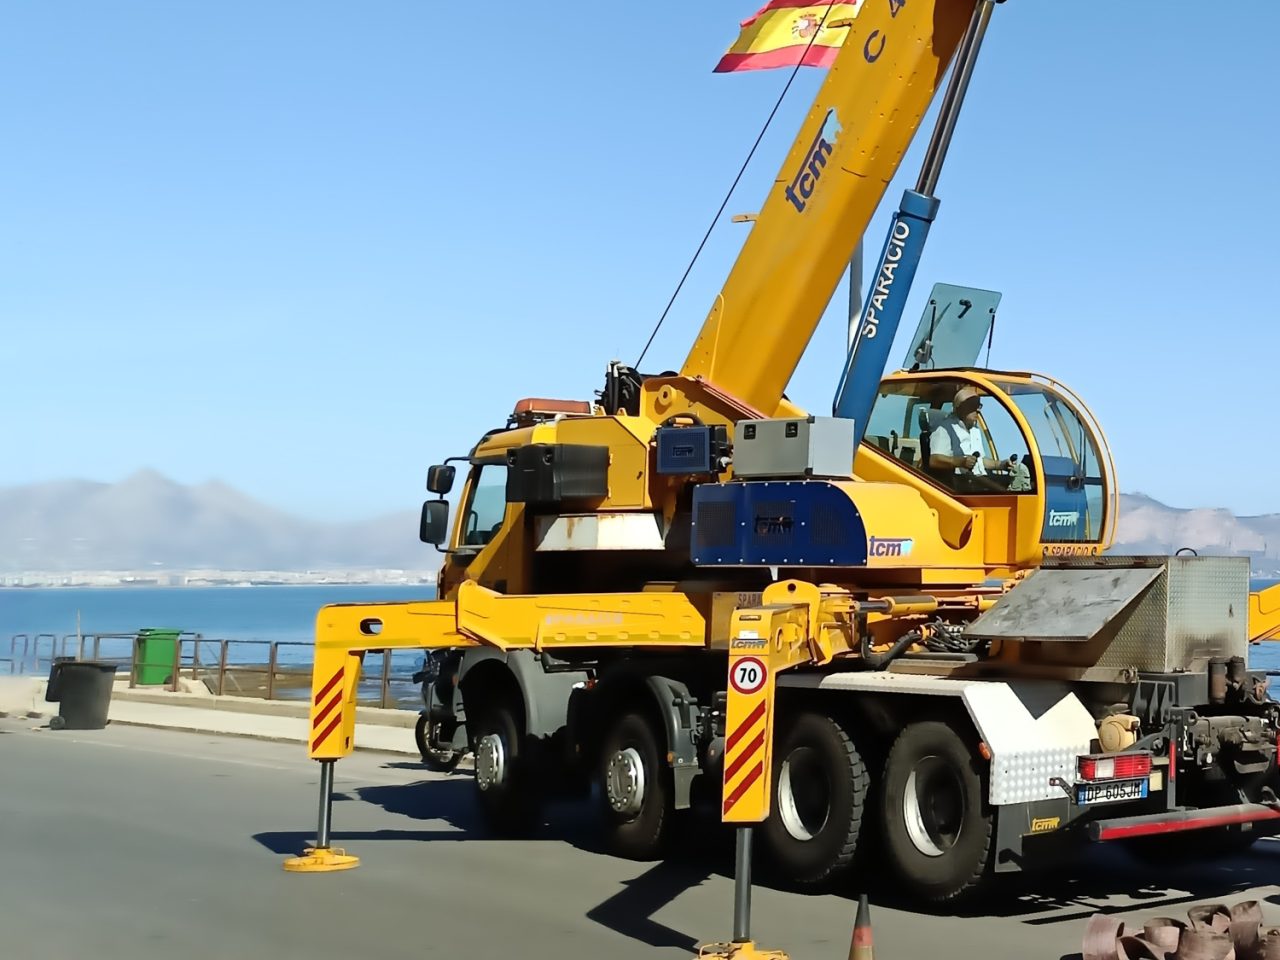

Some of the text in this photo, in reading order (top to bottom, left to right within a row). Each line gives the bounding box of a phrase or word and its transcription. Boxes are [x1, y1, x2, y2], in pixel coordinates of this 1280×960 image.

[863, 29, 886, 63] C
[785, 108, 835, 213] tcm
[862, 221, 910, 338] SPARACIO
[1049, 509, 1075, 526] tcm
[869, 536, 908, 556] tcm
[740, 668, 757, 683] 70
[1087, 786, 1101, 801] DP
[1032, 817, 1058, 831] tcm
